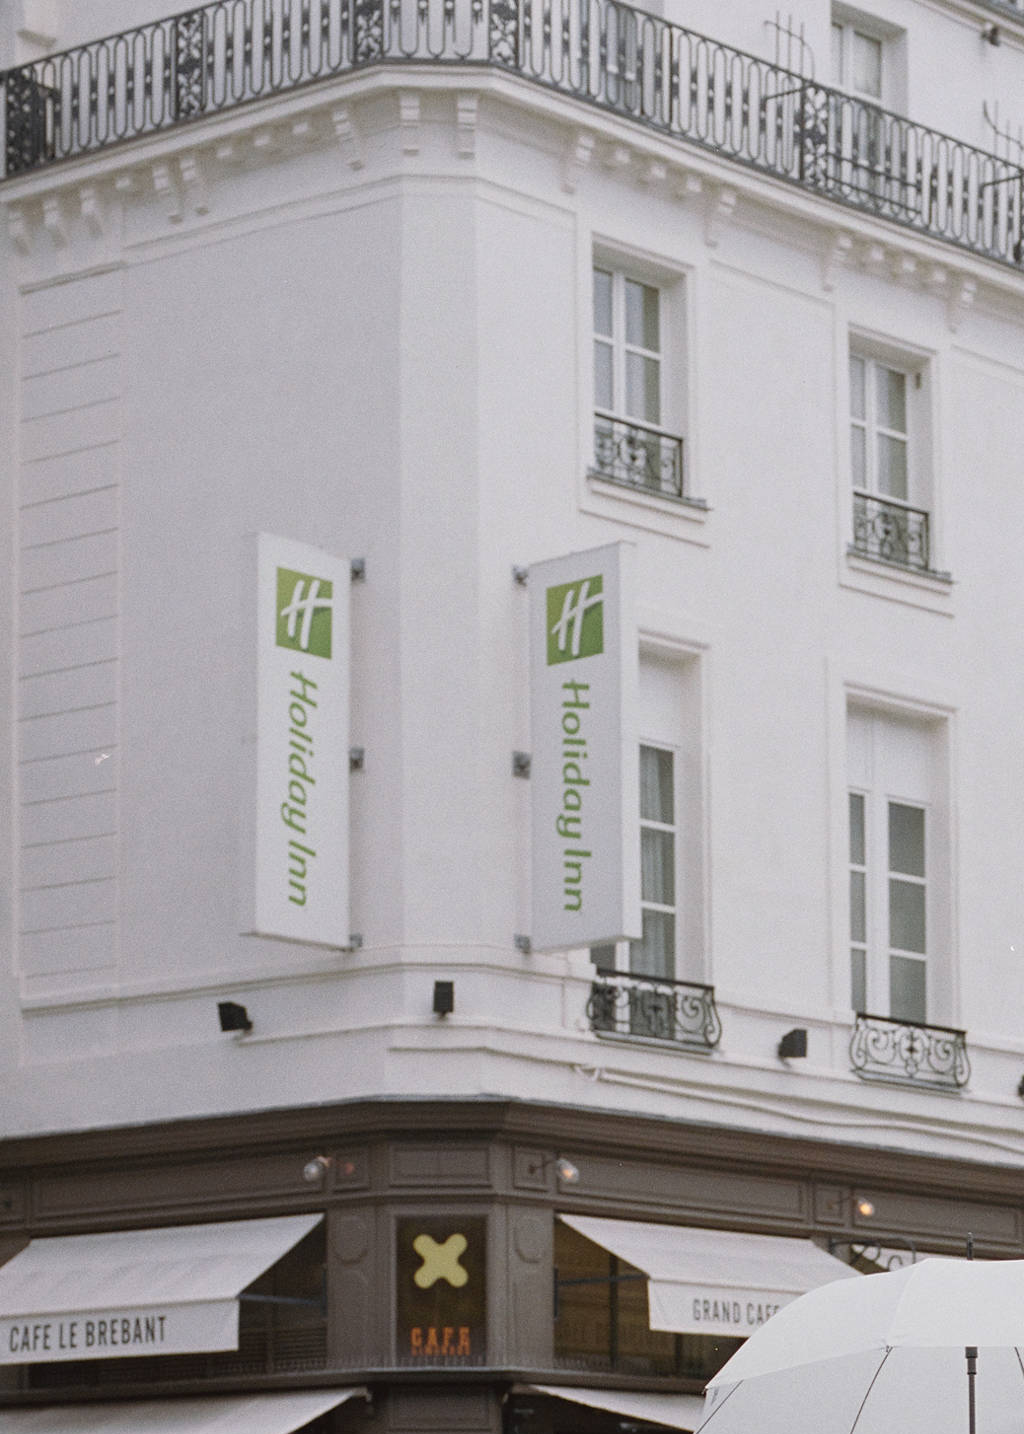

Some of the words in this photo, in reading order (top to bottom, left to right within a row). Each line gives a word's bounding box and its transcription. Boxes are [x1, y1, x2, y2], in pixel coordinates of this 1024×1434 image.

[280, 670, 319, 834] Holiday
[555, 678, 591, 840] Holiday
[287, 838, 317, 907] Inn
[563, 848, 592, 912] Inn
[9, 1323, 52, 1352] CAFE
[58, 1321, 78, 1349] LE
[85, 1315, 166, 1347] BREBANT
[692, 1298, 742, 1324] GRAND
